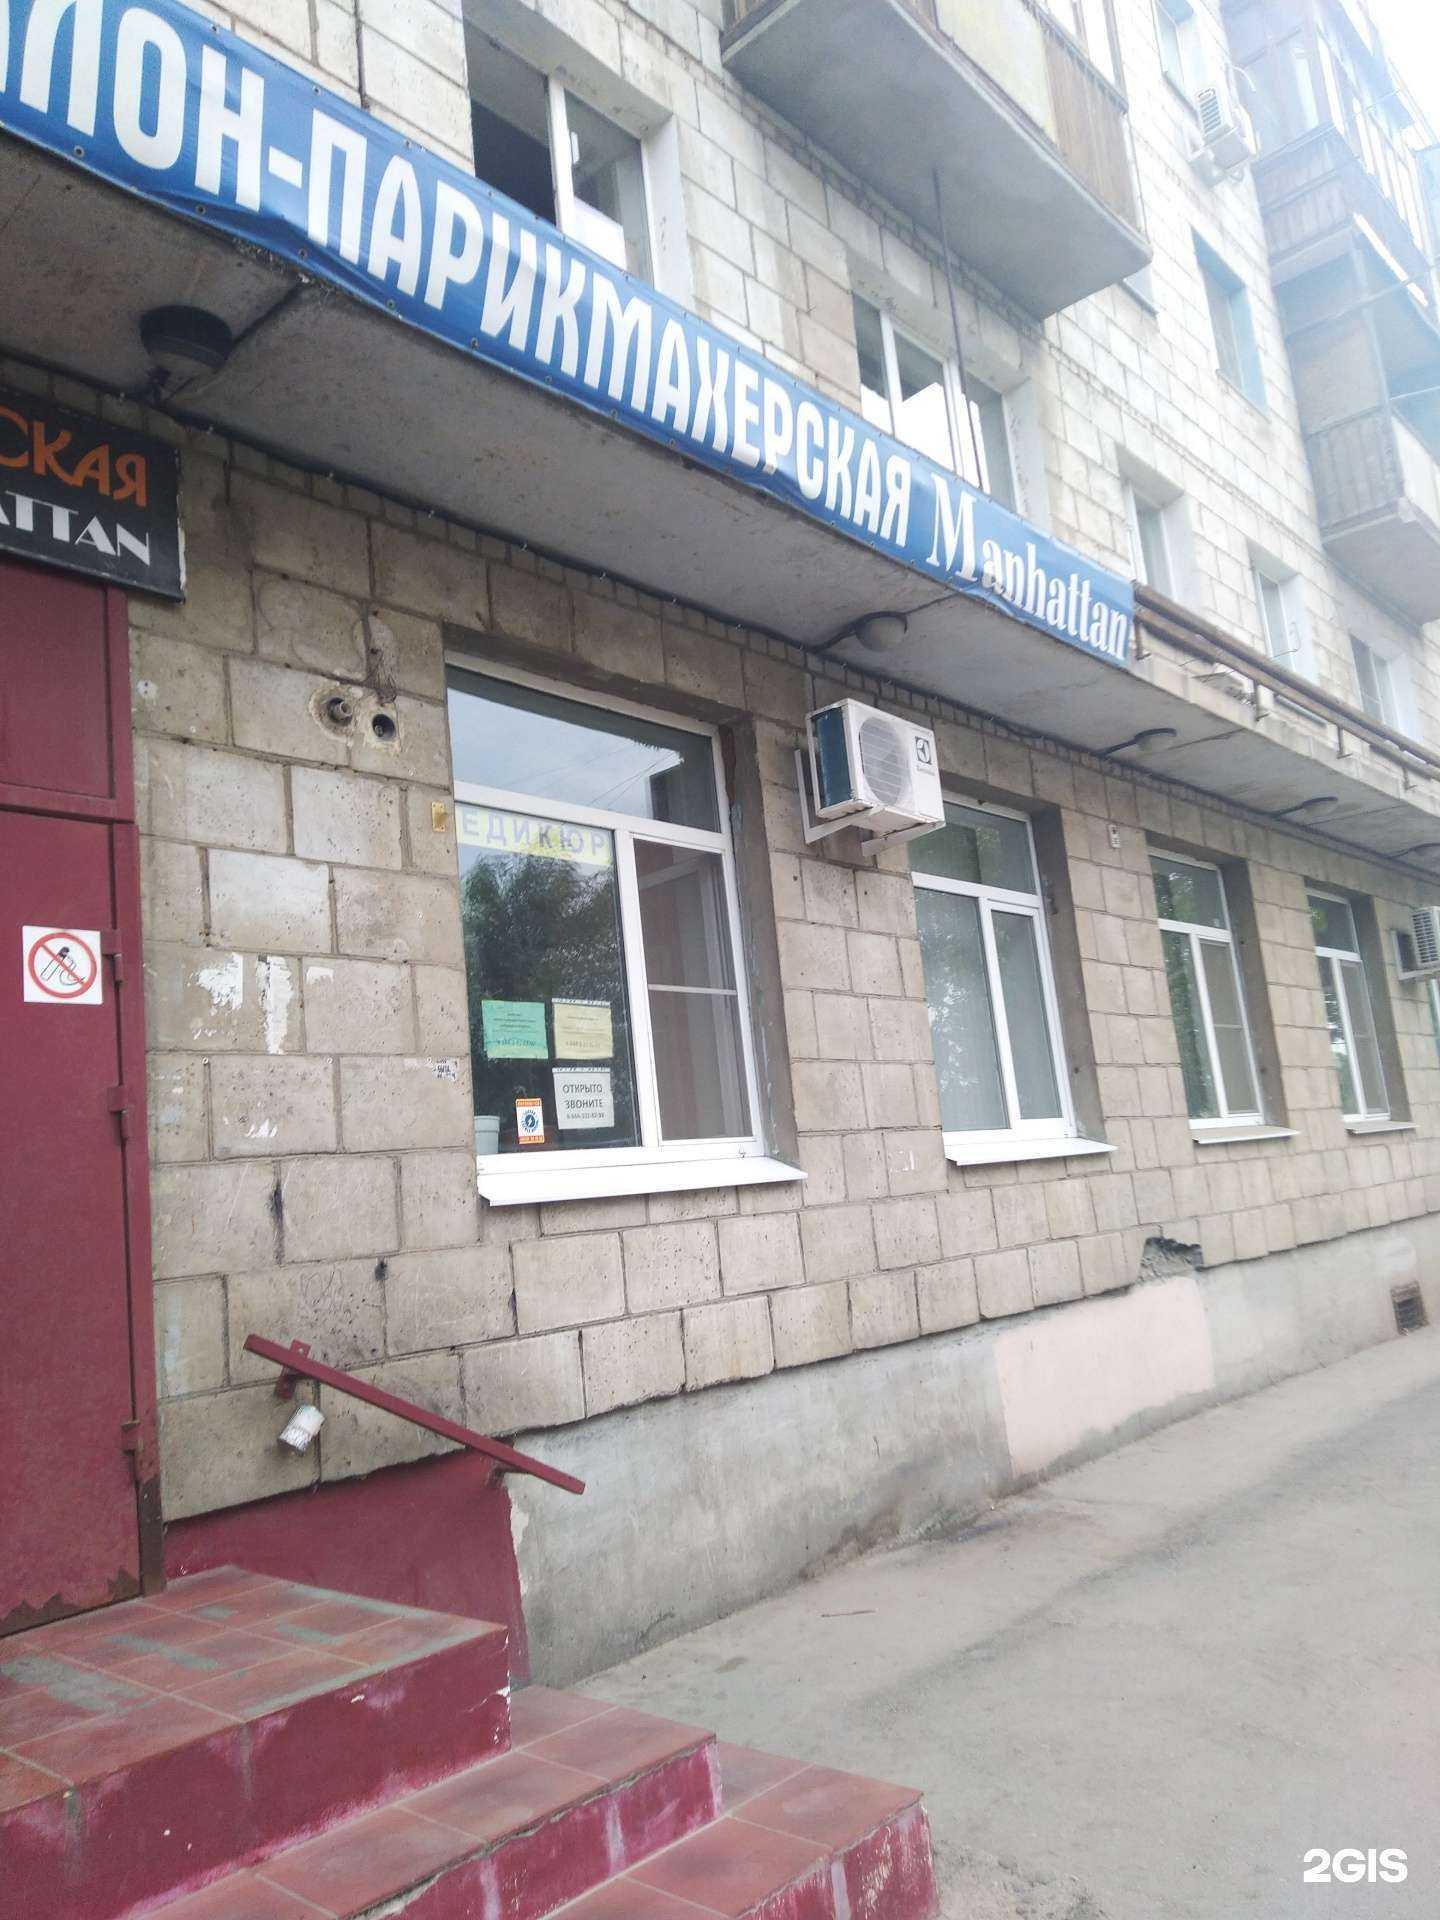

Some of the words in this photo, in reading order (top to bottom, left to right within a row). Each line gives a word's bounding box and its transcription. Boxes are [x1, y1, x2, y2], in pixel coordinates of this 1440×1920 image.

[0, 0, 911, 548] ЛОН-ПАРИКМАХЕРСКАЯ
[926, 471, 1131, 663] Manhattan
[0, 490, 151, 567] TTAN
[562, 1083, 603, 1094] ОТКРЫТО
[564, 1099, 604, 1109] ЗВОНИТЕ
